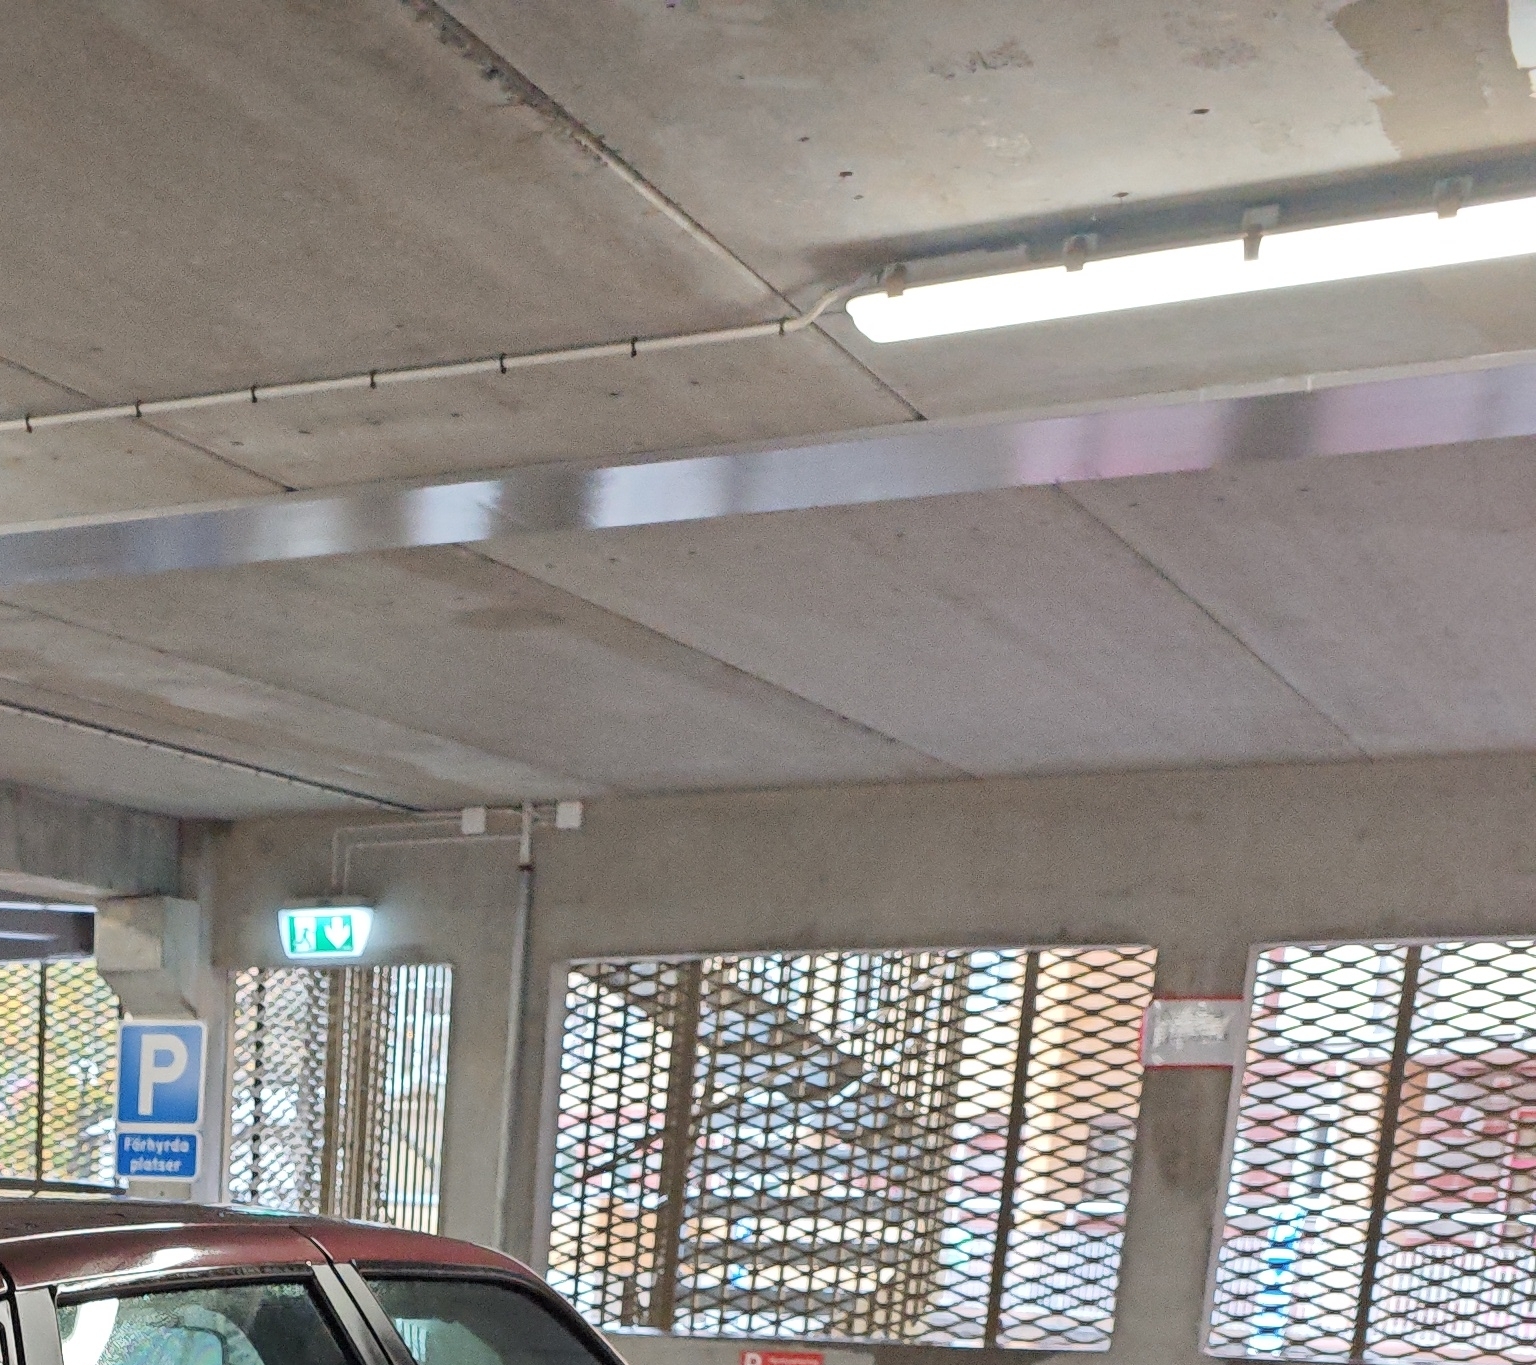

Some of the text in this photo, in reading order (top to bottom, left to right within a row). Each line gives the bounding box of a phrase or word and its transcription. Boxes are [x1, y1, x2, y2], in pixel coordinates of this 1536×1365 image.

[138, 1033, 188, 1116] P
[124, 1135, 189, 1155] Förhyrda
[129, 1157, 182, 1174] platser
